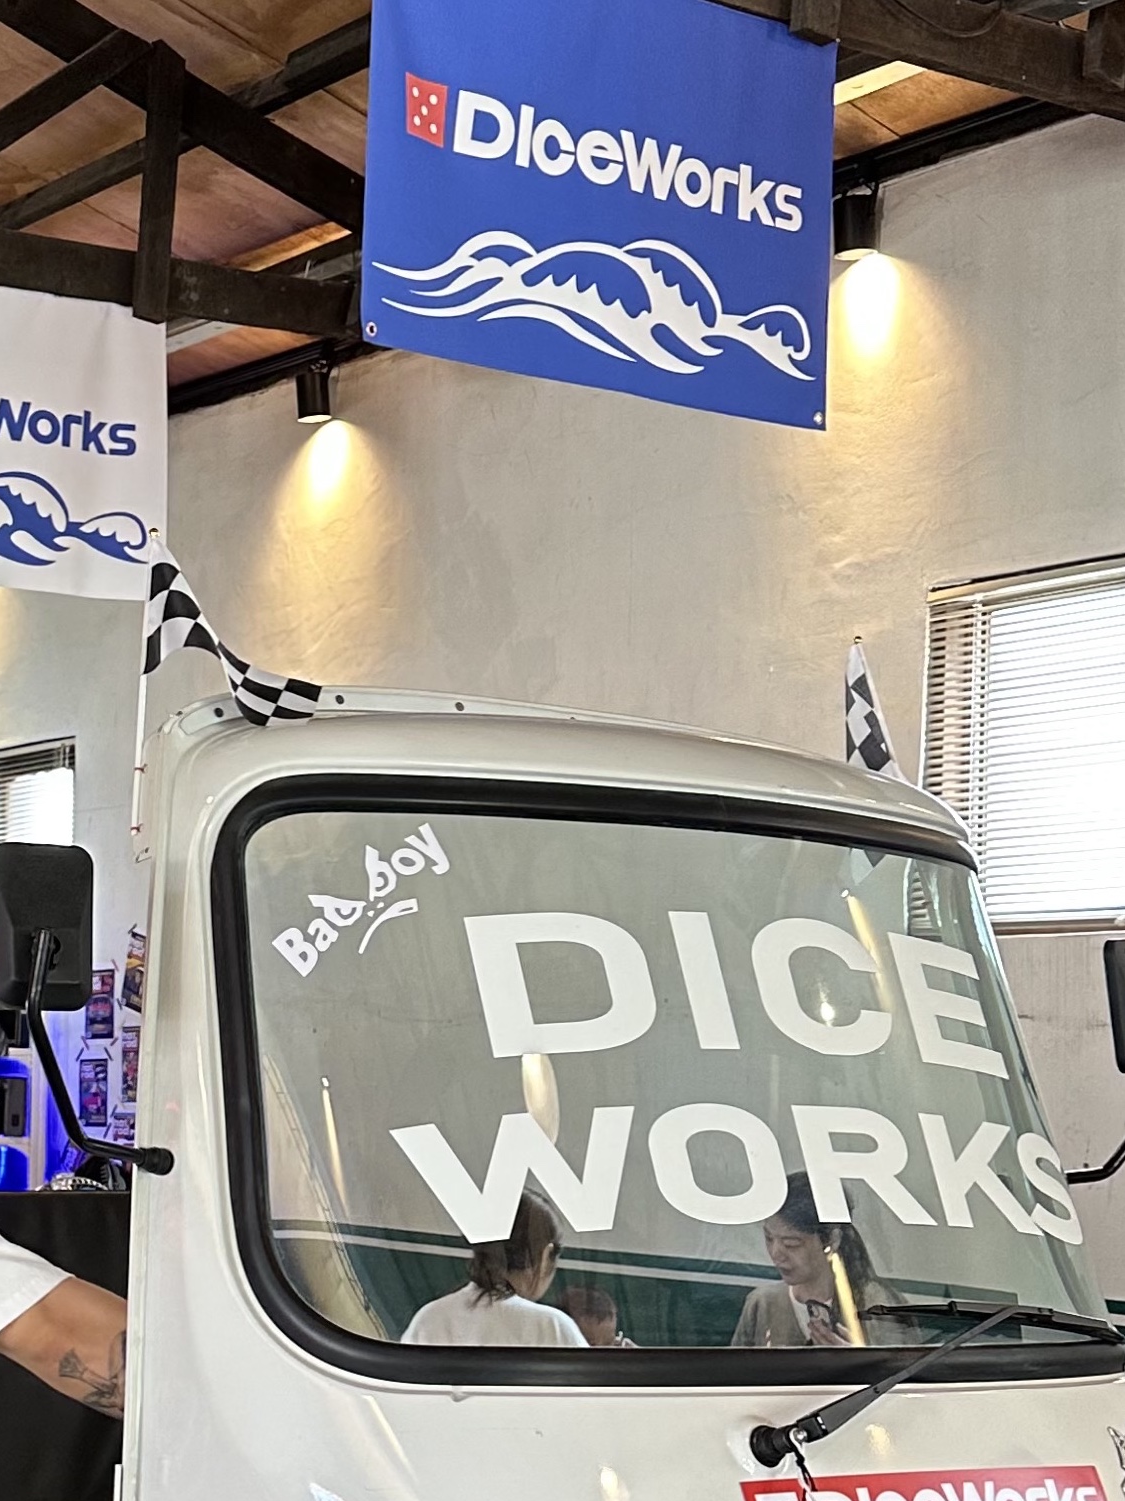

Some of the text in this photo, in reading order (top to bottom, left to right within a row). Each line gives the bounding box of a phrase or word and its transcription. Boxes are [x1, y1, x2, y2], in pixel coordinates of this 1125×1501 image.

[271, 822, 450, 977] Bad boy
[462, 910, 1010, 1081] DICE
[388, 1102, 1084, 1246] WORKS
